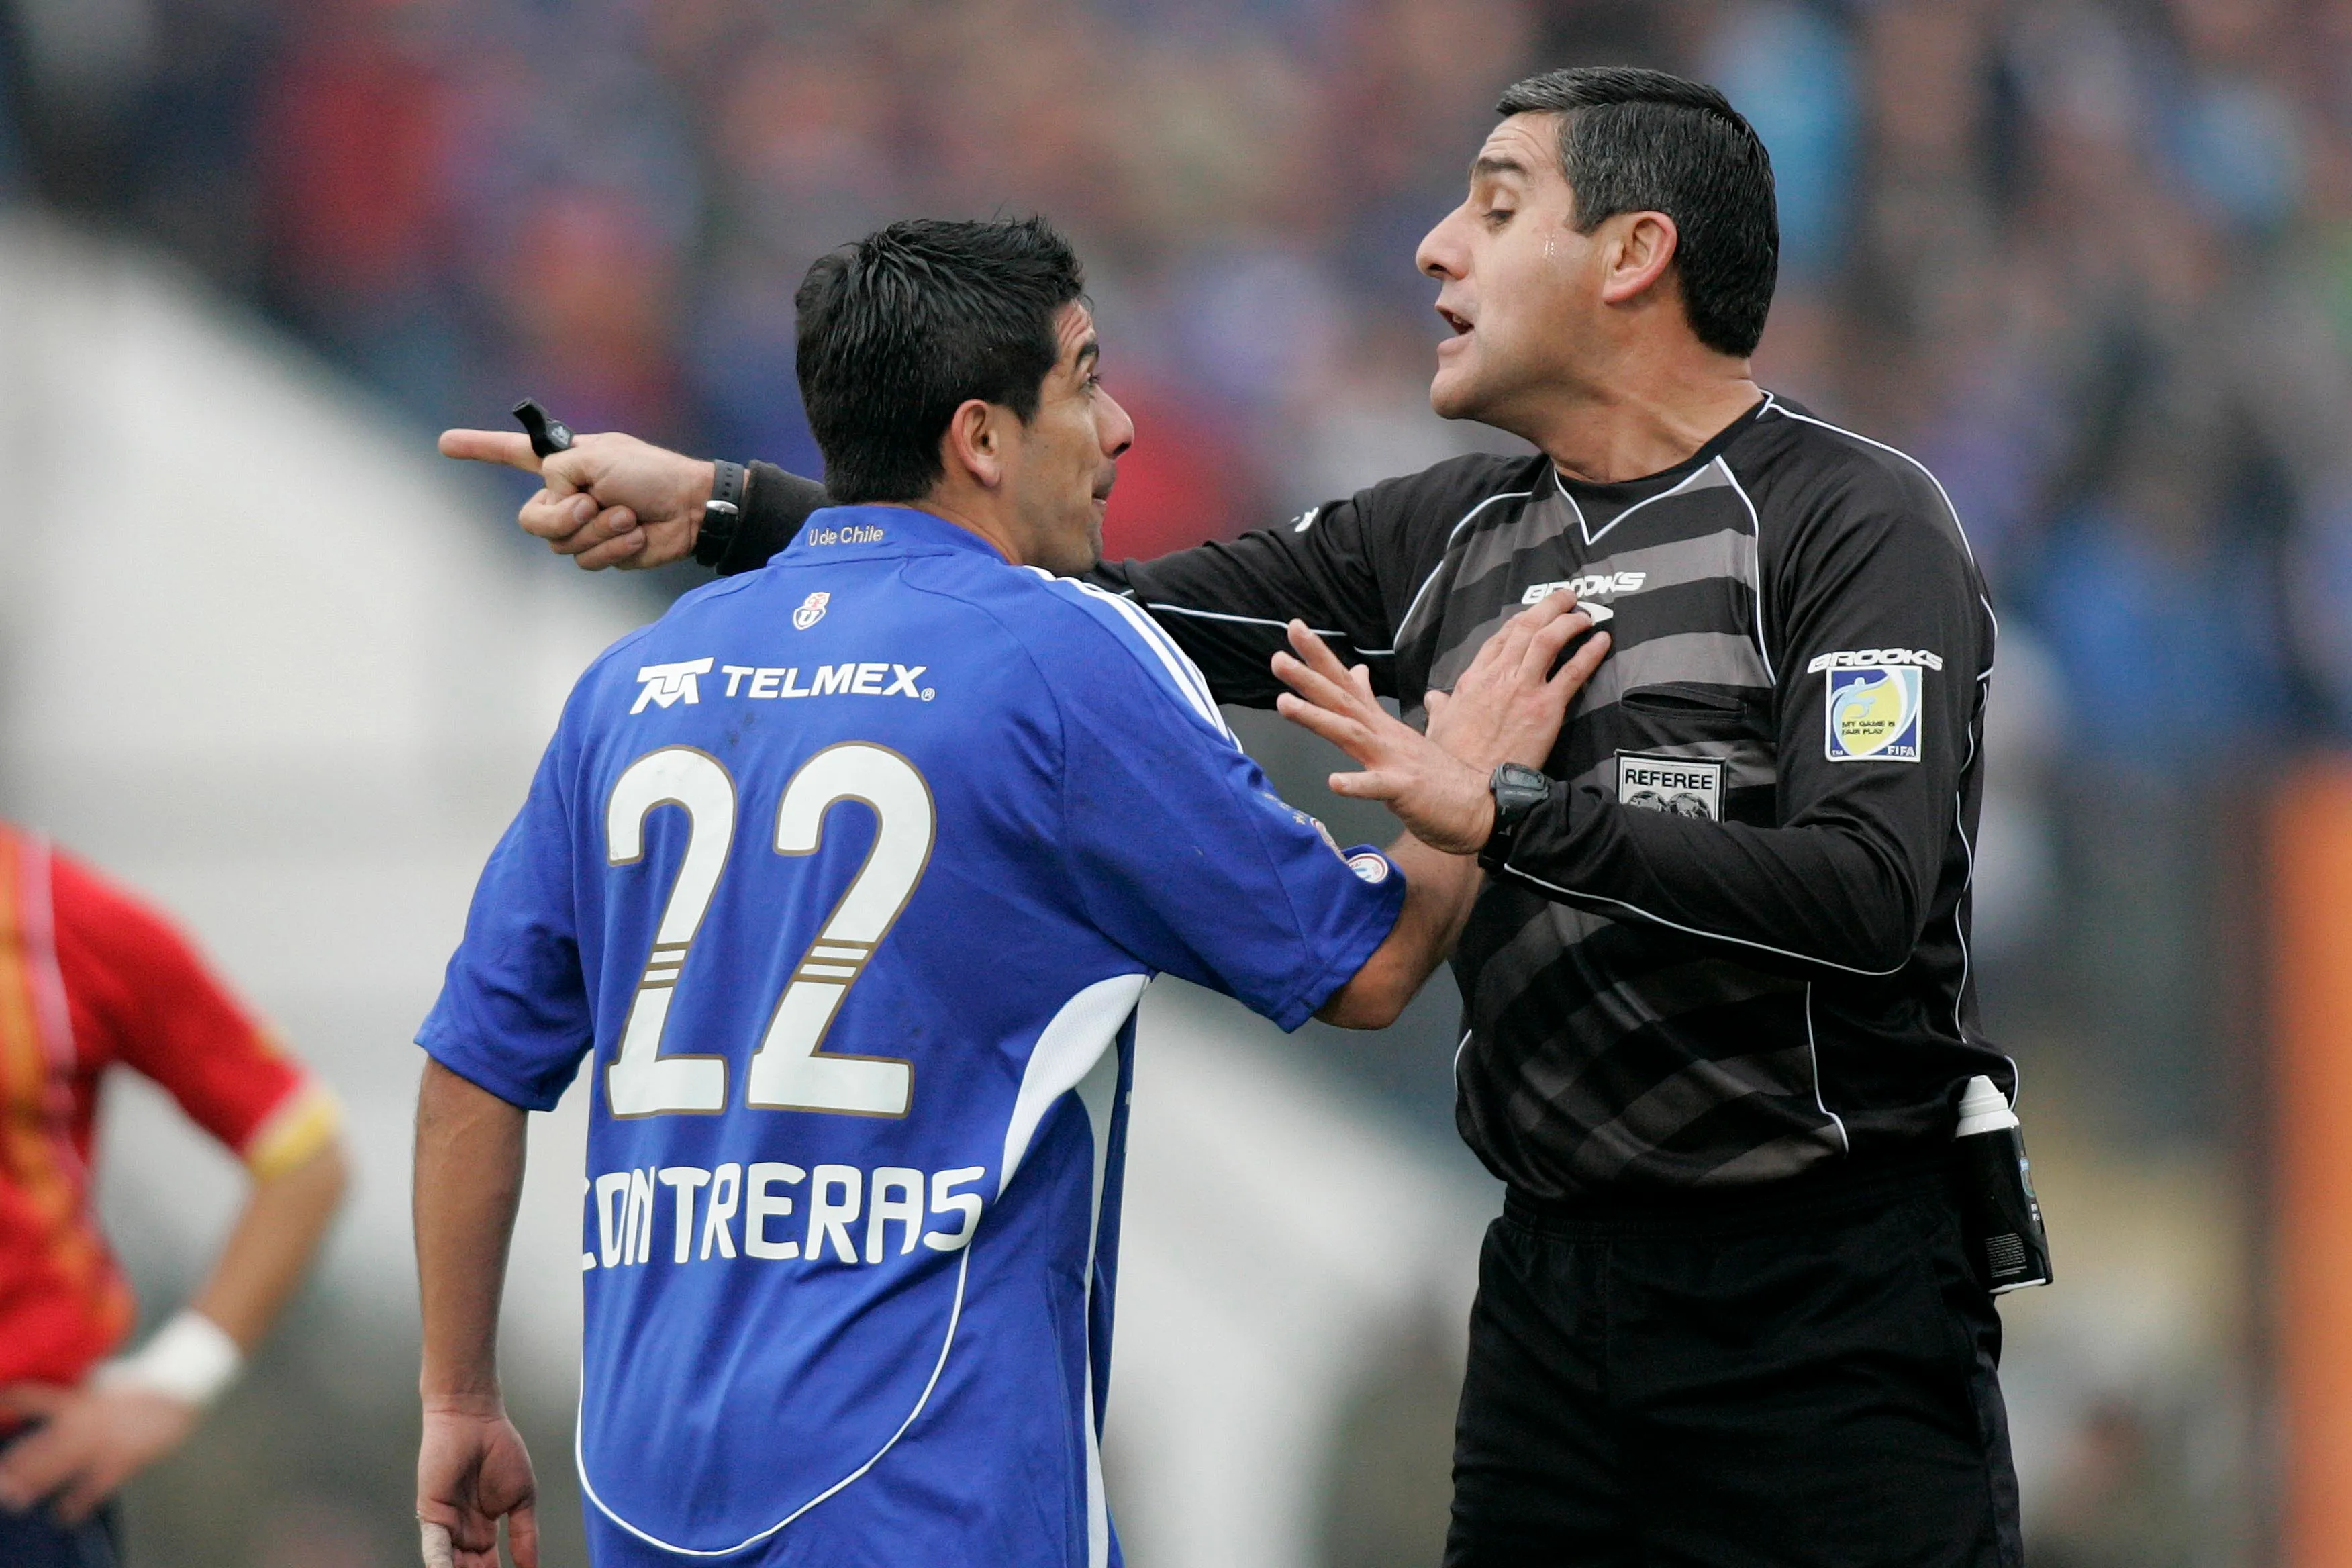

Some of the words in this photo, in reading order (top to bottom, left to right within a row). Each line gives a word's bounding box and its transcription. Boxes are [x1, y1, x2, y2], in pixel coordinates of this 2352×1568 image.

[809, 528, 819, 546] U
[820, 527, 838, 545] de
[840, 525, 884, 543] Chile
[1807, 648, 1943, 674] BROOKS
[721, 663, 927, 699] TELMEX
[1887, 745, 1916, 756] FIFA
[1625, 769, 1714, 790] REFEREE
[605, 740, 938, 1120] 22
